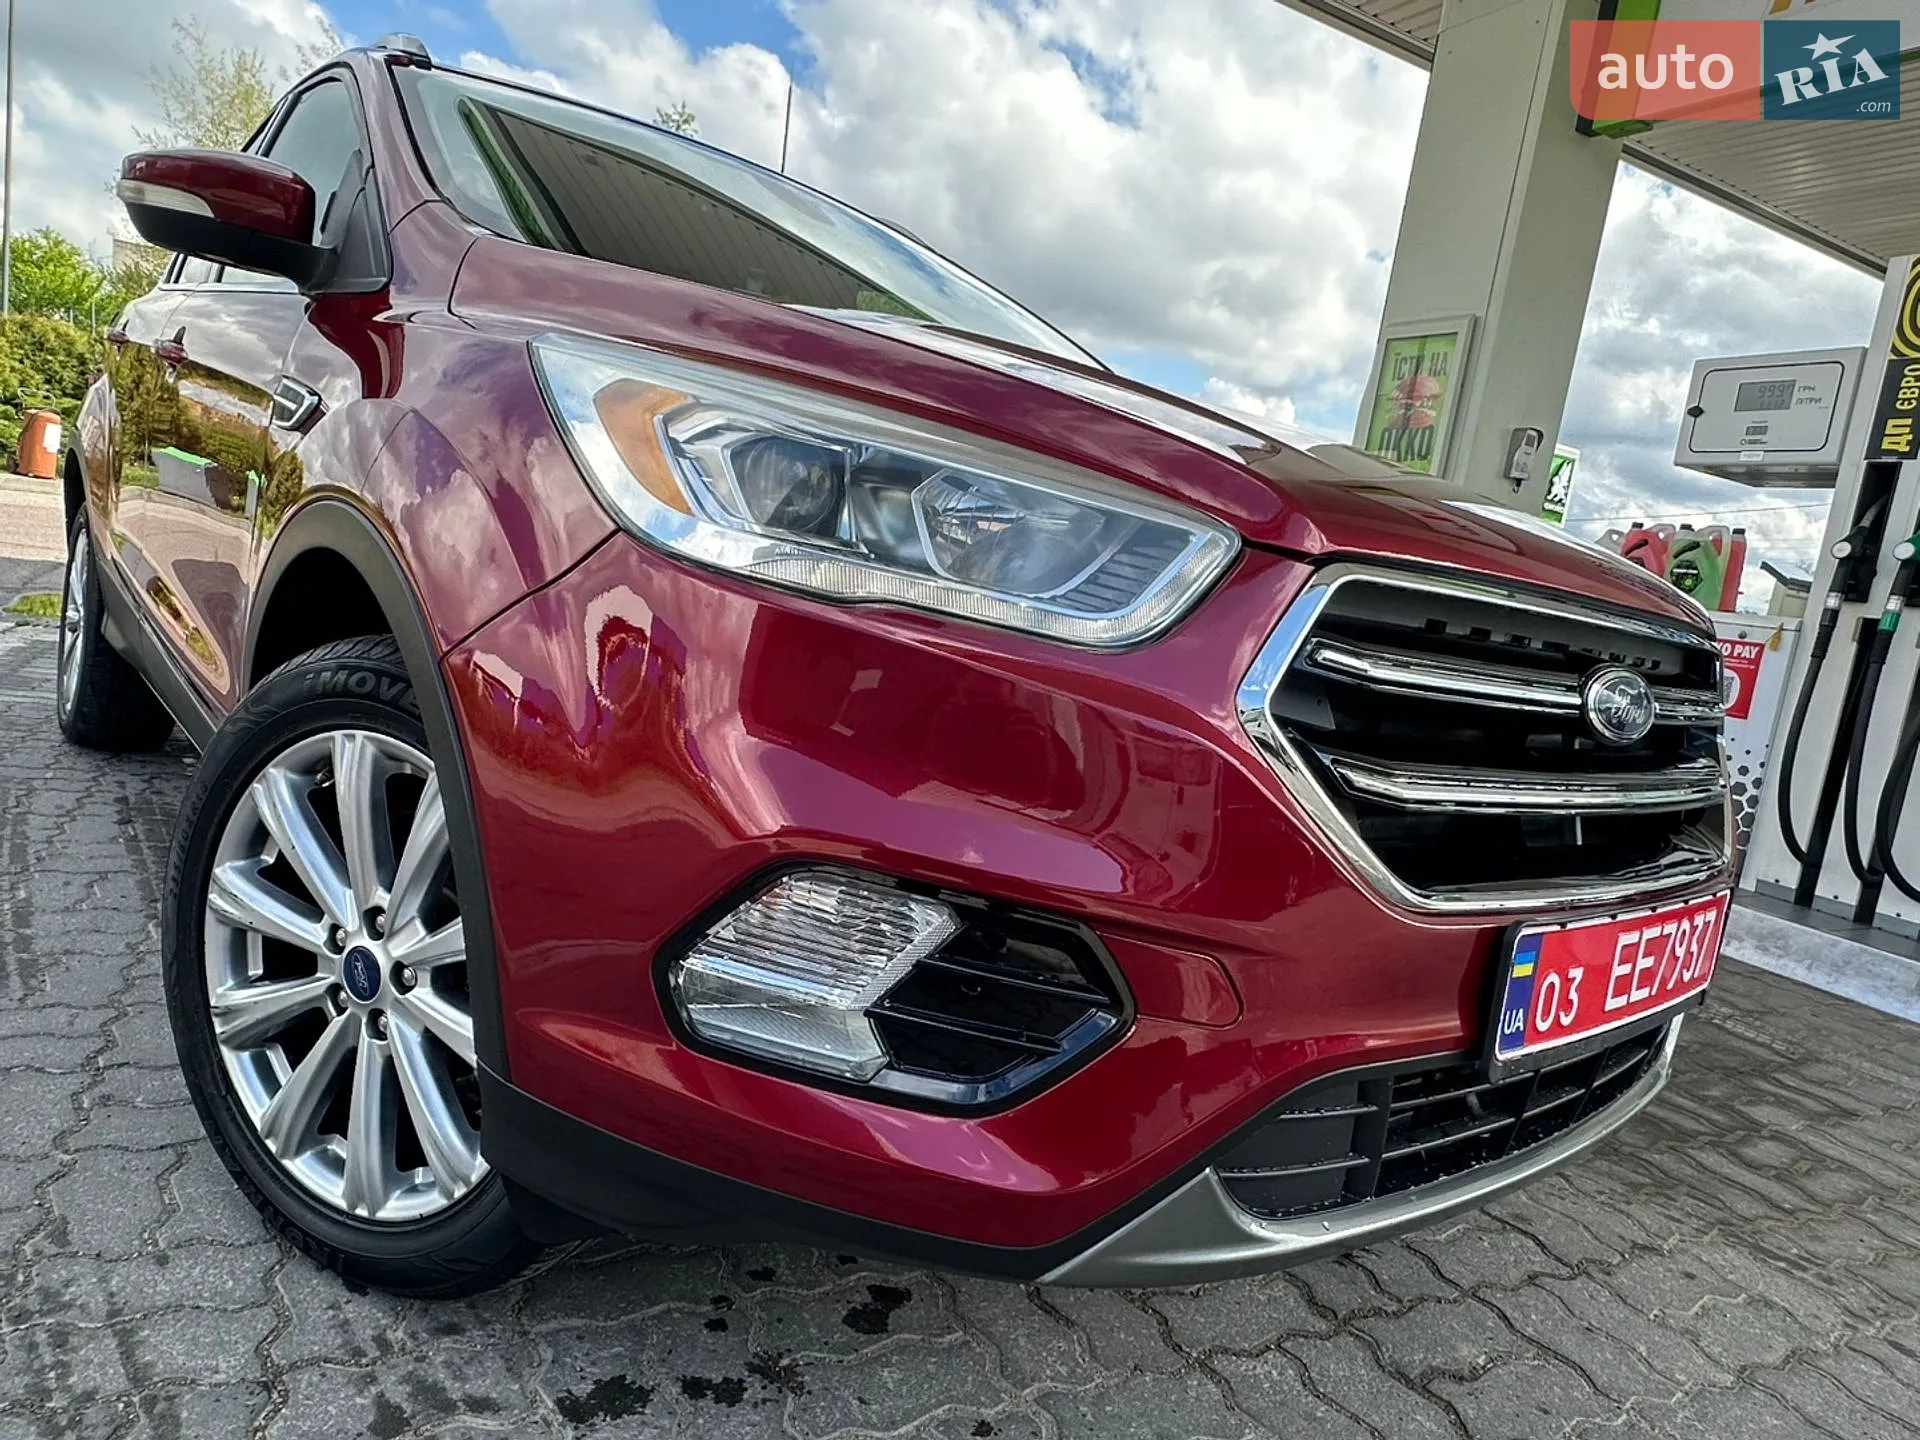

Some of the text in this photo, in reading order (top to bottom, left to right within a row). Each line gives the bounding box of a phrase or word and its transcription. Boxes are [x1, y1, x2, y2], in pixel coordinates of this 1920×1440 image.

[1428, 352, 1448, 377] НА
[1881, 417, 1914, 452] ДП
[1733, 644, 1760, 659] PAY
[1535, 906, 1718, 1033] 03 EE7937
[1503, 1008, 1525, 1035] UA
